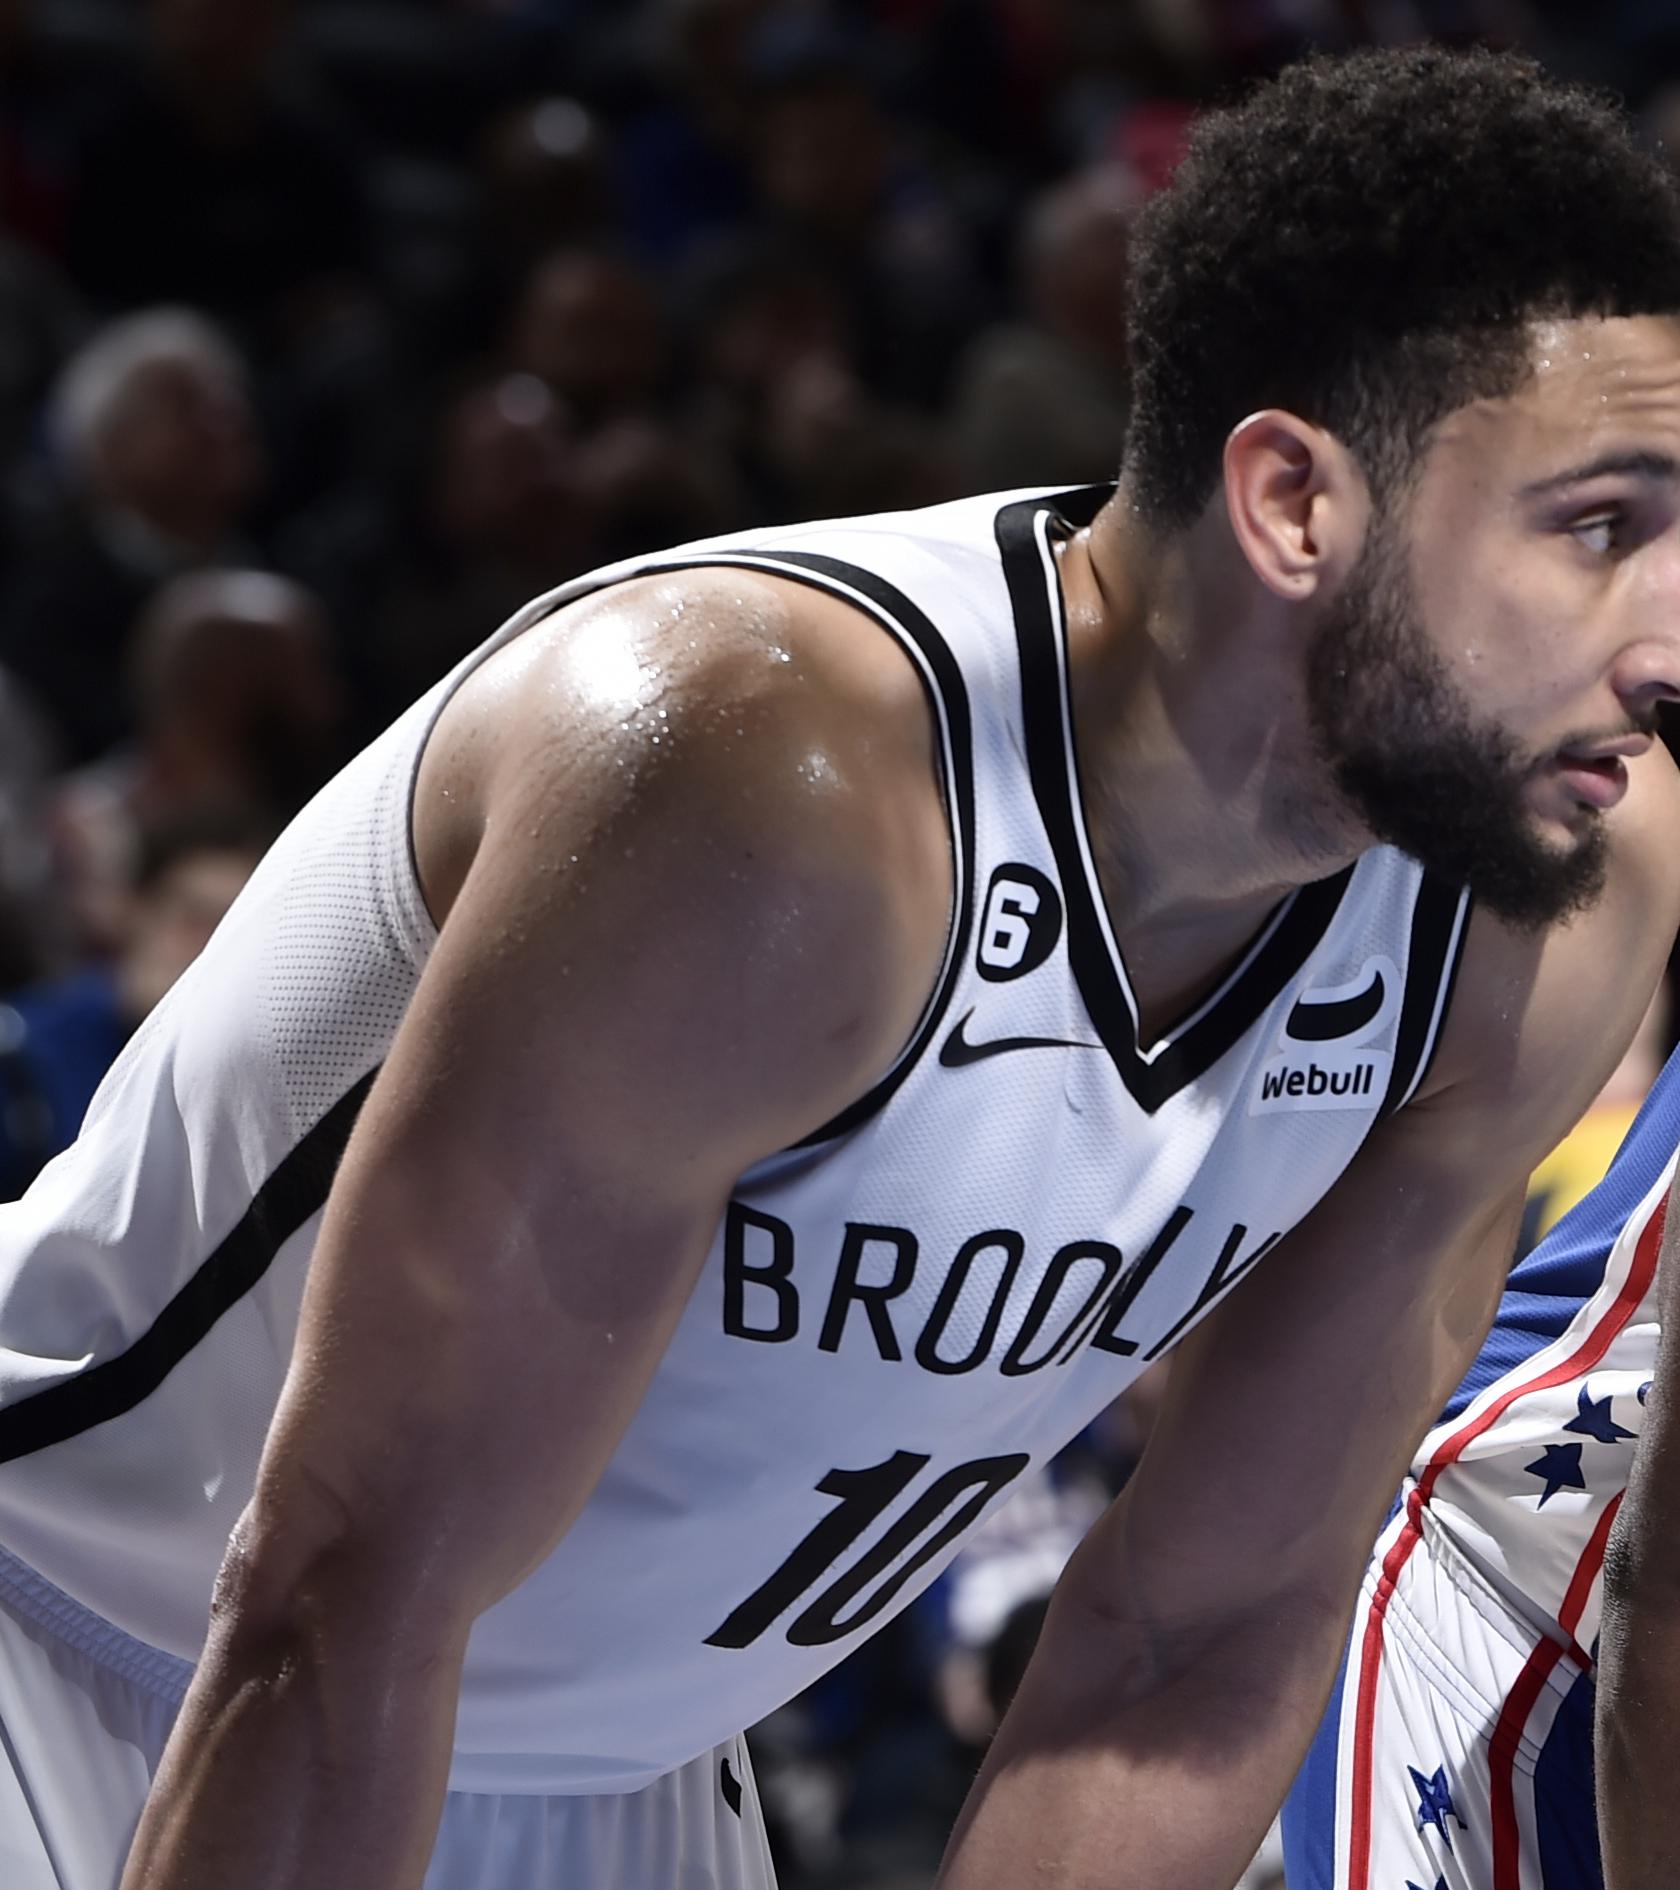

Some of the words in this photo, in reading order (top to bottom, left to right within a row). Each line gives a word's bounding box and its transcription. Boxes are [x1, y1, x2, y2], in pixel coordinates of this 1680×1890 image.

[980, 879, 1041, 969] 6
[1261, 1064, 1374, 1101] Webull
[723, 1199, 1283, 1377] BROOLY
[701, 1449, 1031, 1650] 10
